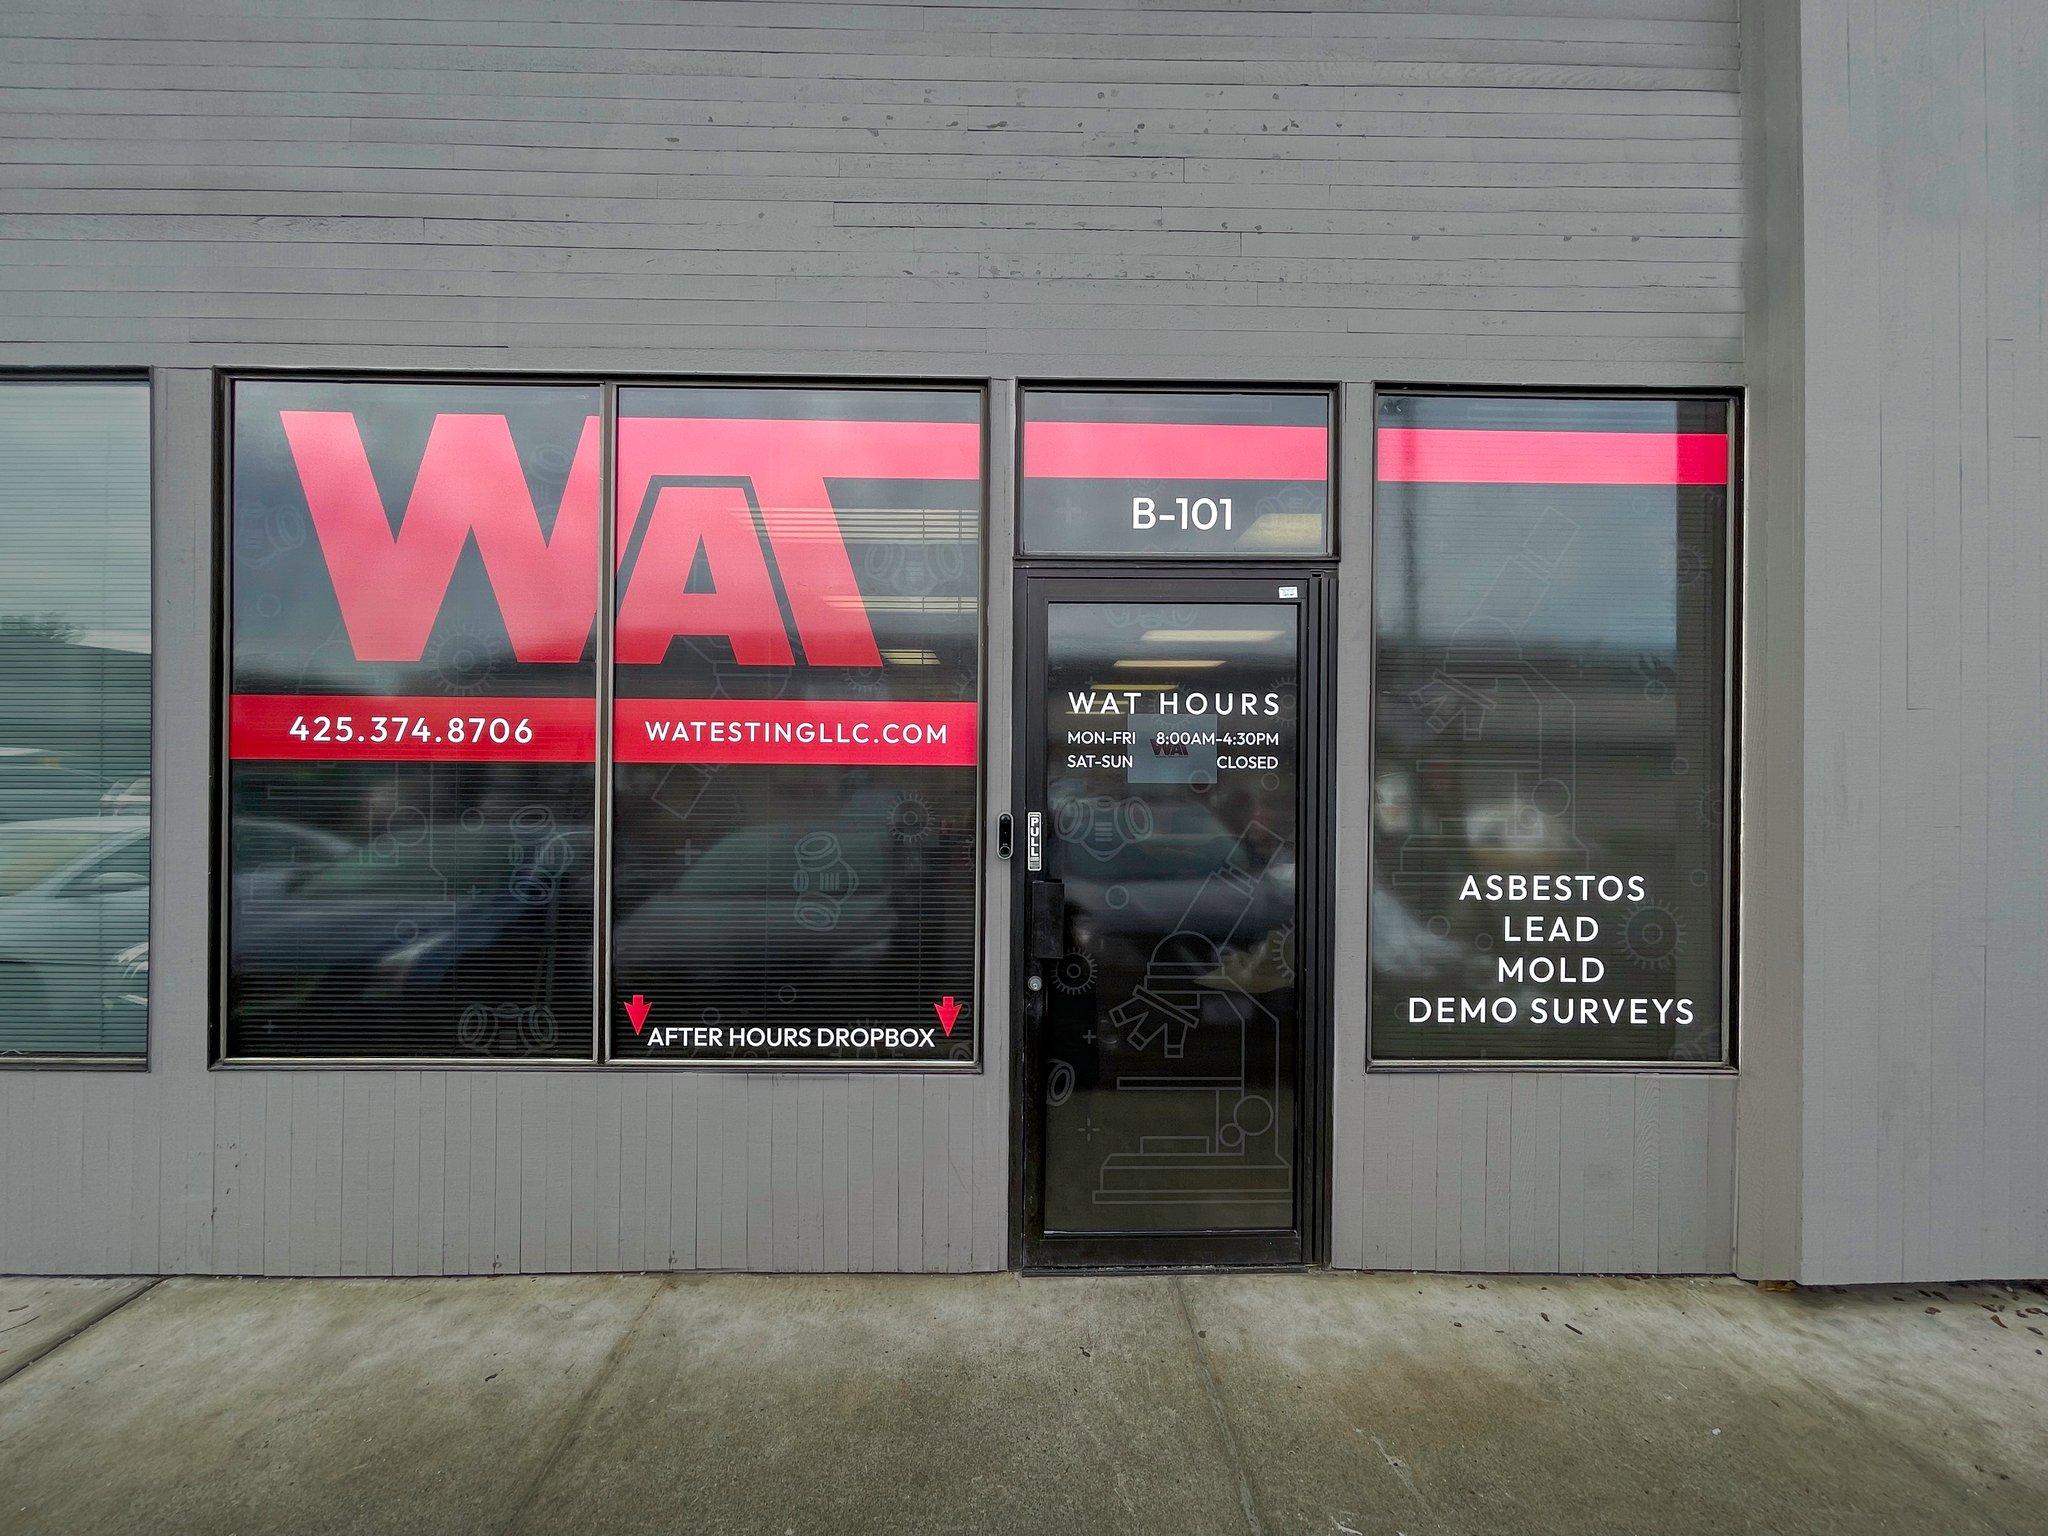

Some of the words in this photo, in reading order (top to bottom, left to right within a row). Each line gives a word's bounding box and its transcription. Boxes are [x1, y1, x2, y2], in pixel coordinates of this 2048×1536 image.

[1132, 497, 1233, 530] B-101
[279, 410, 980, 667] WAT
[1067, 691, 1142, 715] WAT
[1159, 692, 1280, 716] HOURS
[289, 716, 533, 745] 425.374.8706
[645, 721, 948, 745] WATESTINGLLC.COM
[1067, 731, 1136, 745] MON-FRI
[1156, 731, 1280, 746] 8:00AM-4:30PM
[1067, 754, 1133, 769] SAT-SUN
[1216, 755, 1279, 770] CLOSED
[1030, 817, 1040, 857] PULL
[1458, 874, 1646, 902] ASBESTOS
[1503, 915, 1600, 942] LEAD
[1497, 956, 1606, 983] MOLD
[1408, 996, 1518, 1024] DEMO
[1529, 996, 1695, 1025] SURVEYS
[646, 1027, 724, 1048] AFTER
[729, 1027, 812, 1048] HOURS
[817, 1027, 937, 1048] DROPBOX
